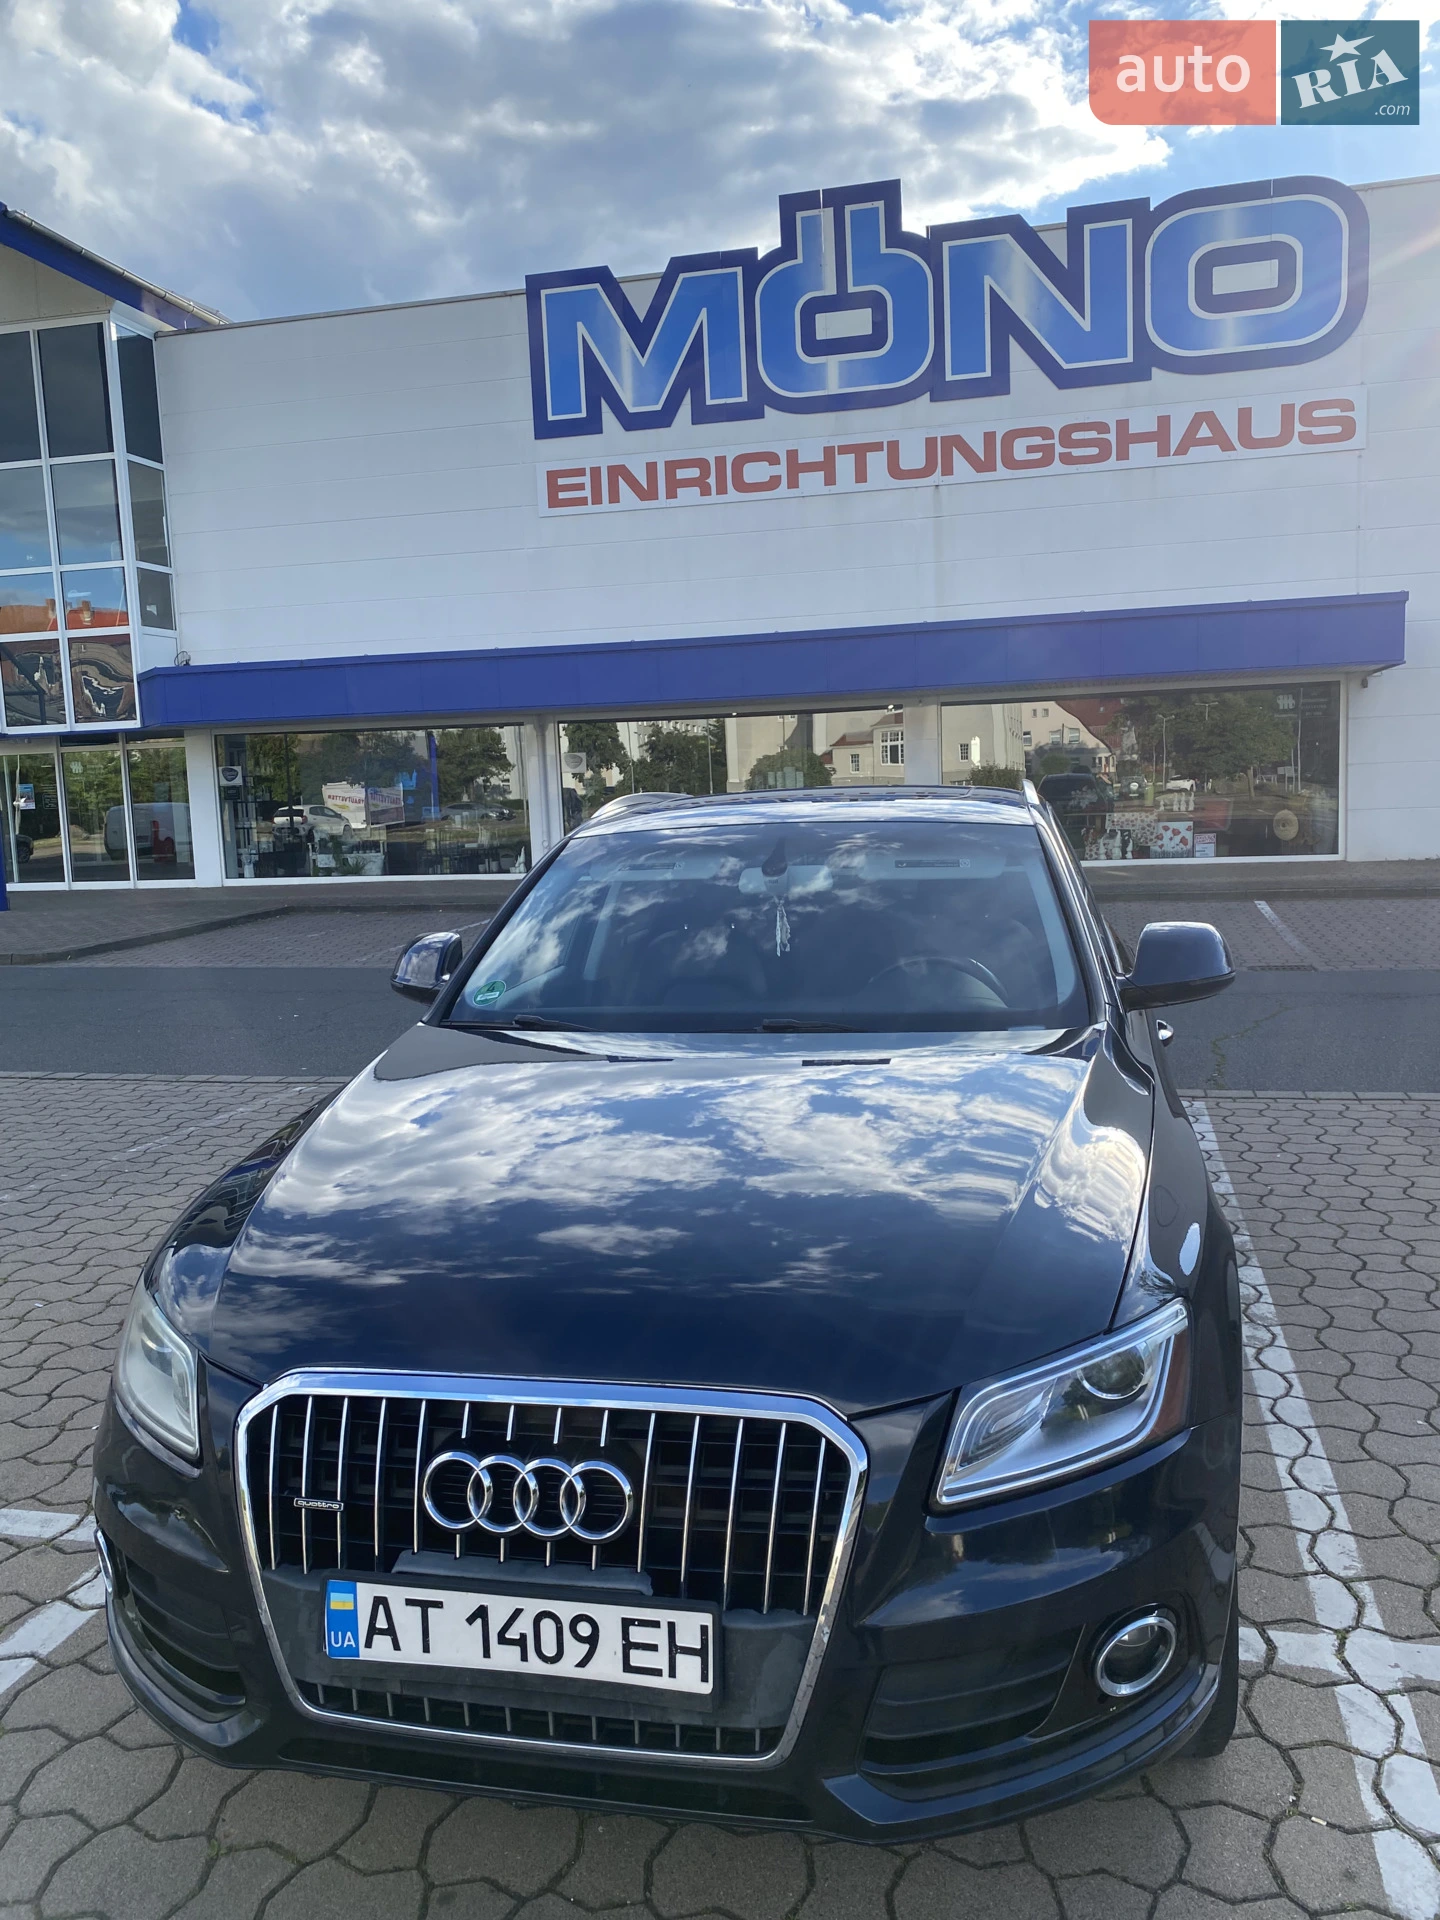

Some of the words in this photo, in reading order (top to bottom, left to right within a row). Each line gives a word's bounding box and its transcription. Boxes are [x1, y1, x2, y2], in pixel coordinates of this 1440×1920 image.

[546, 398, 1358, 509] EINRICHTUNGSHAUS
[297, 1500, 340, 1509] quattro
[331, 1630, 356, 1648] UA
[364, 1595, 444, 1654] AT
[465, 1604, 600, 1669] 1409
[621, 1616, 710, 1684] EH
